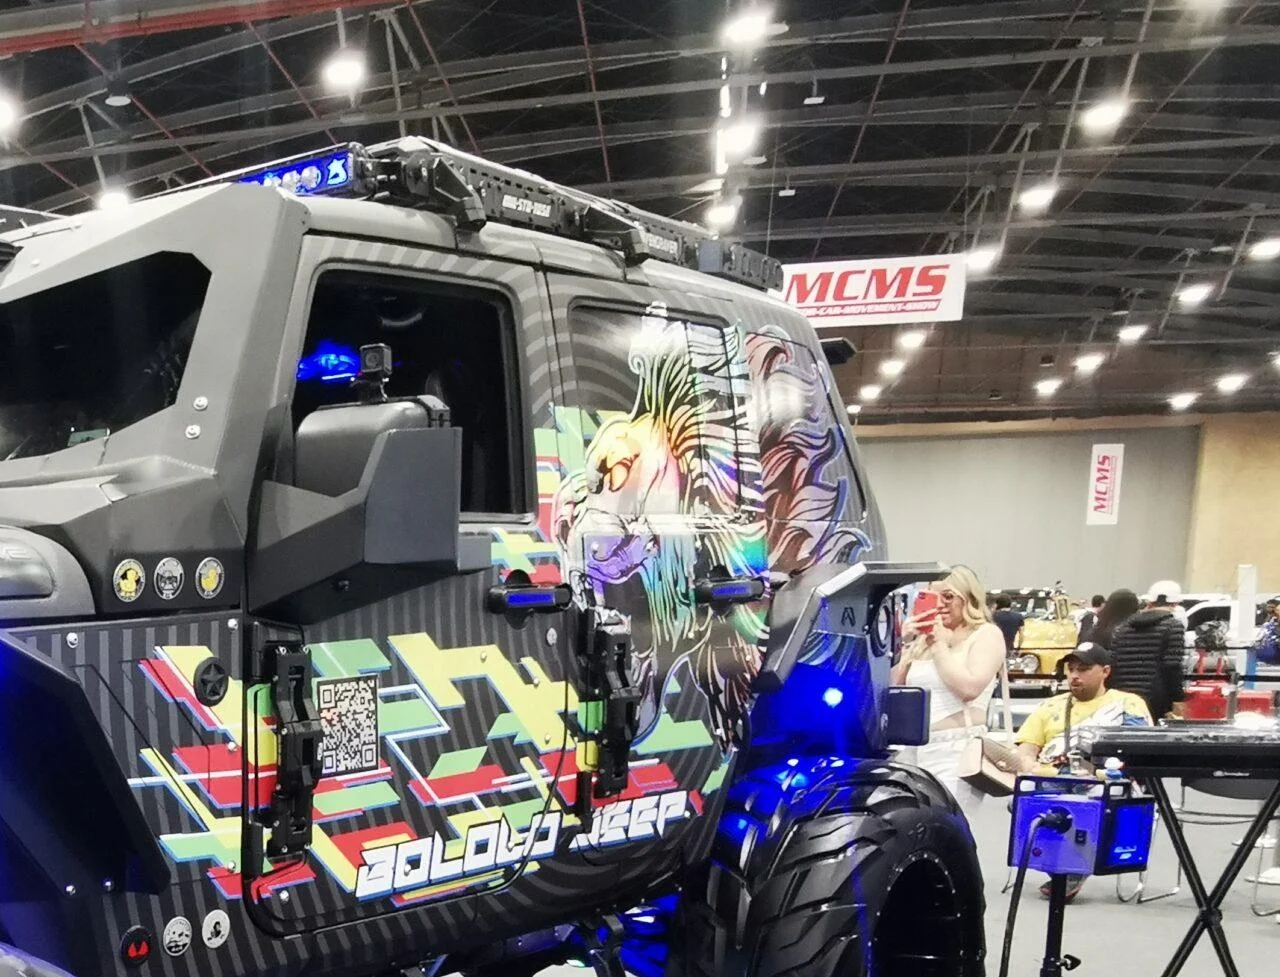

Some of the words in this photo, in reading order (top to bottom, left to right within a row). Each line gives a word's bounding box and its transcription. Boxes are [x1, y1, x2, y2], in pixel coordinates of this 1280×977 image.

[785, 264, 950, 304] MCMS
[1093, 454, 1110, 514] MCMS
[568, 790, 689, 851] JEEP
